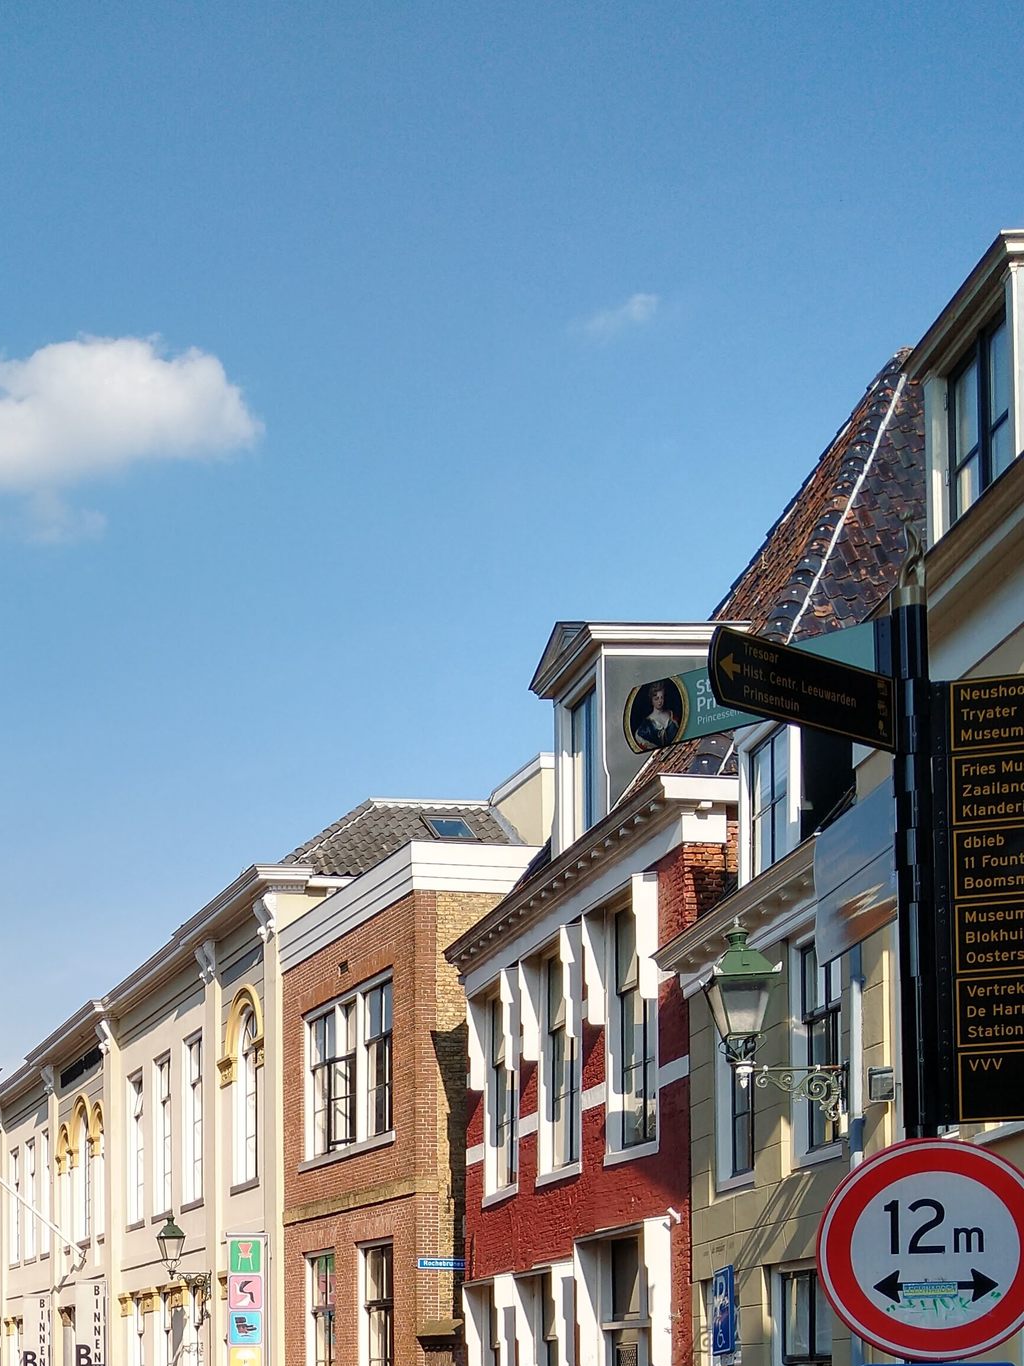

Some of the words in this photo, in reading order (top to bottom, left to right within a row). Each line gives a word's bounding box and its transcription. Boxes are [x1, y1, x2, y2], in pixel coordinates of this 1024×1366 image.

[744, 643, 779, 663] Tresoar
[696, 678, 712, 695] St
[801, 680, 857, 708] Leeuwarden
[696, 696, 717, 712] Pri
[743, 685, 800, 712] Prinsentuin
[961, 706, 1018, 722] Tryater
[961, 726, 1024, 741] Museum
[961, 763, 996, 777] Fries
[1001, 759, 1024, 773] Mu
[963, 833, 1005, 848] dbieb
[964, 856, 975, 869] 11
[967, 1005, 986, 1018] De
[992, 1003, 1024, 1016] Har
[967, 1023, 1023, 1038] Station
[969, 1057, 1003, 1072] VVV
